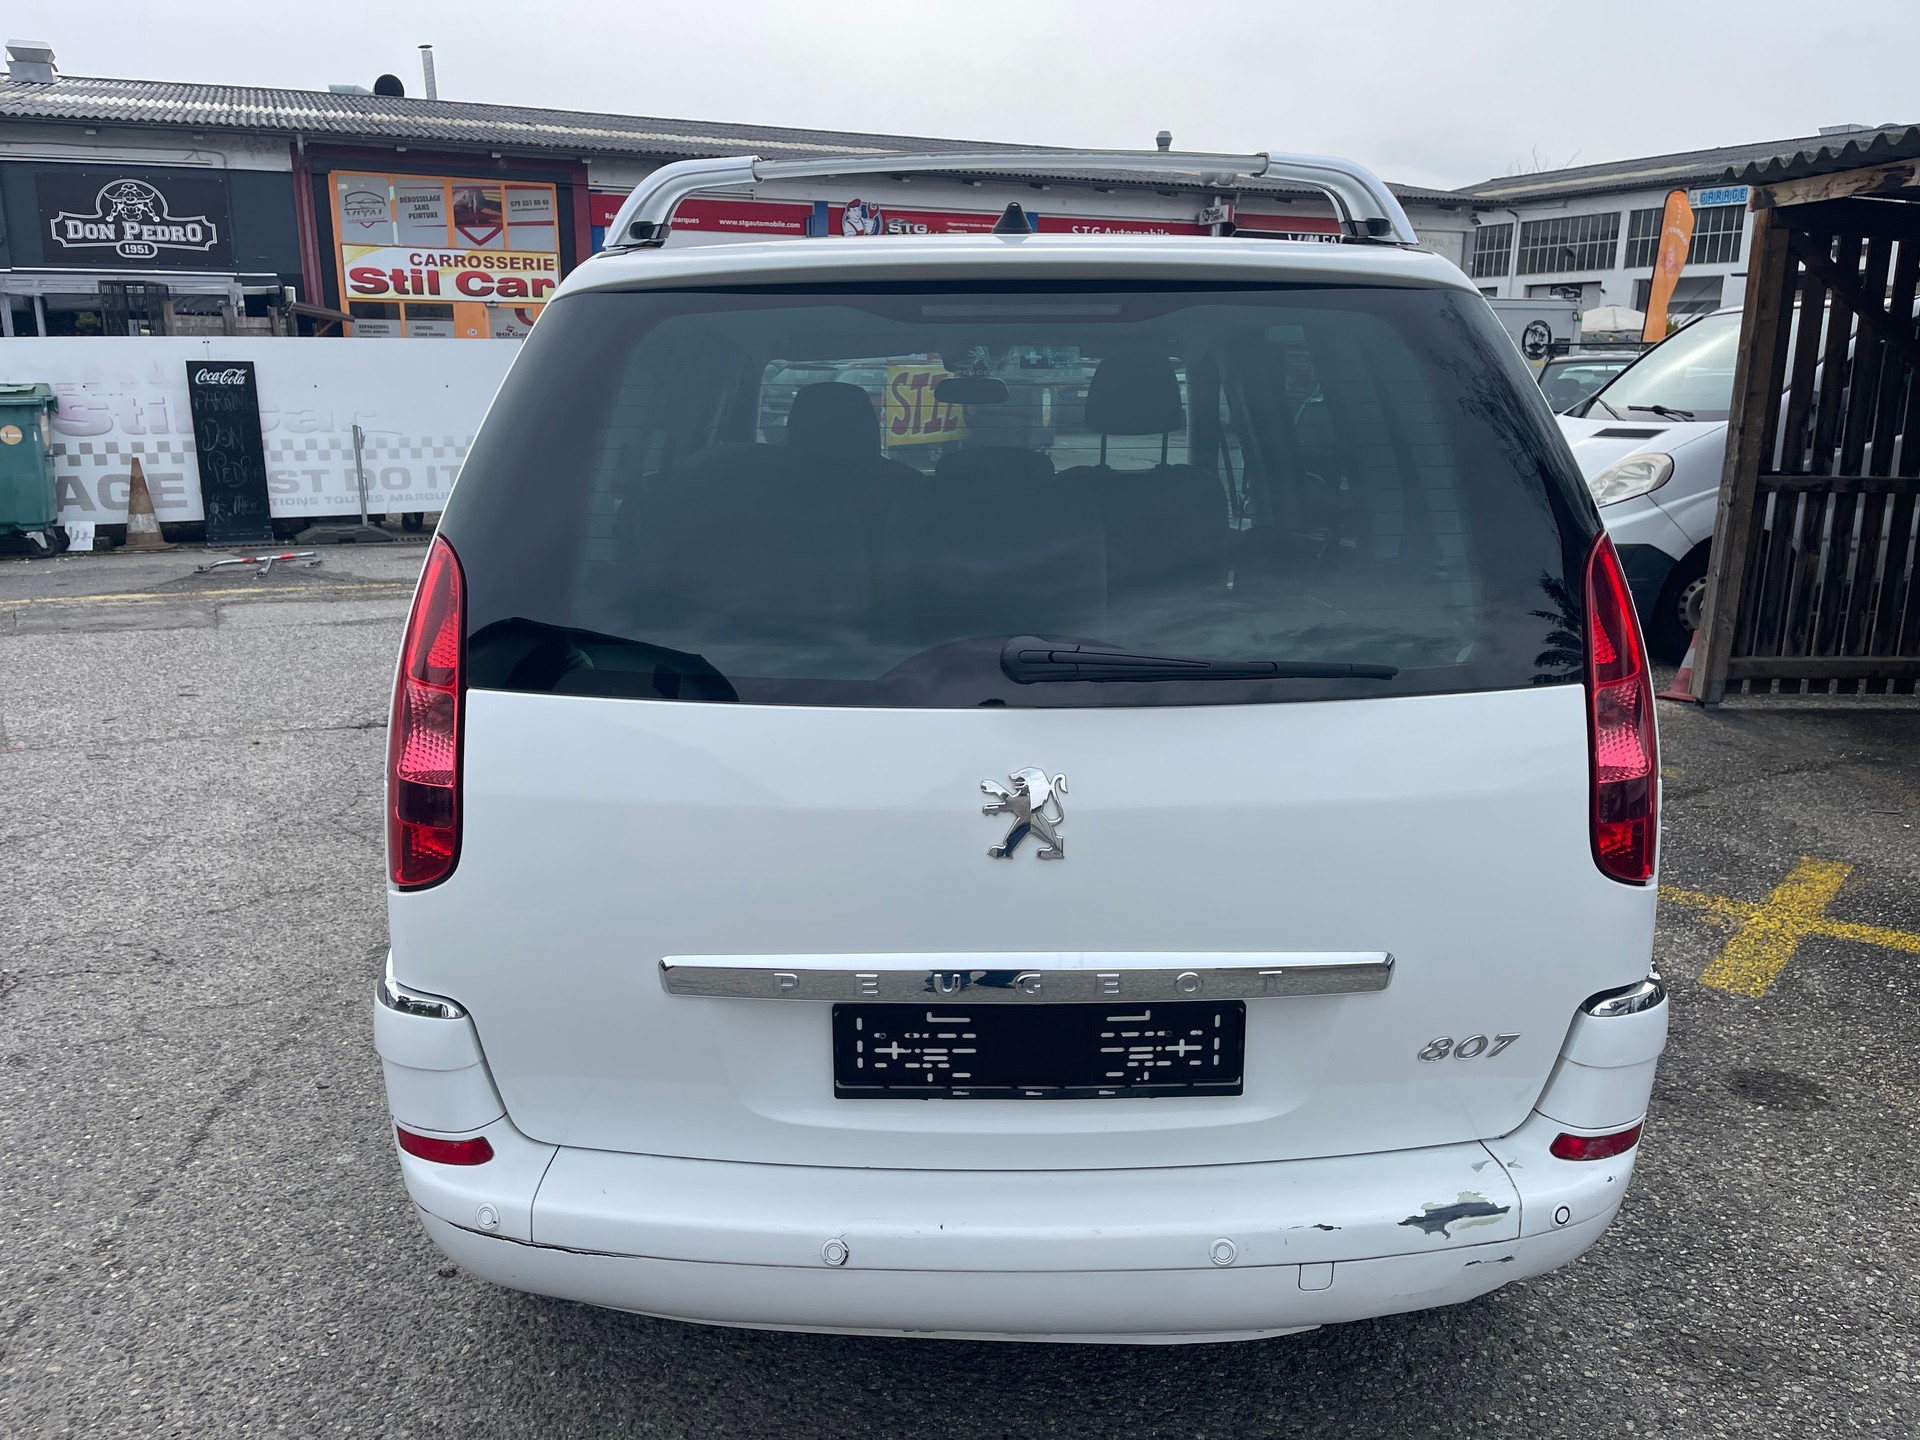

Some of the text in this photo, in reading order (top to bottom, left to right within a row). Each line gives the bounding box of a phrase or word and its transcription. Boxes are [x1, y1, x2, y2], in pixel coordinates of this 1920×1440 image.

[1701, 187, 1748, 205] GARAGE
[408, 211, 439, 220] PEINTURE
[413, 204, 430, 212] SANS
[672, 216, 700, 225] marques
[719, 218, 801, 229] www.stgautomobile.com
[888, 223, 928, 235] STG
[64, 219, 203, 243] DON PEDRO
[124, 244, 150, 255] 1951
[409, 252, 555, 271] CARROSSERIE
[349, 267, 556, 298] Stil Car
[195, 368, 247, 385] Coca-Cola
[201, 418, 245, 455] DON
[344, 466, 412, 492] DO
[271, 497, 319, 506] TIONS
[324, 495, 385, 505] TOUTES
[773, 969, 1283, 997] PEUGEOT
[1417, 1032, 1522, 1062] 807
